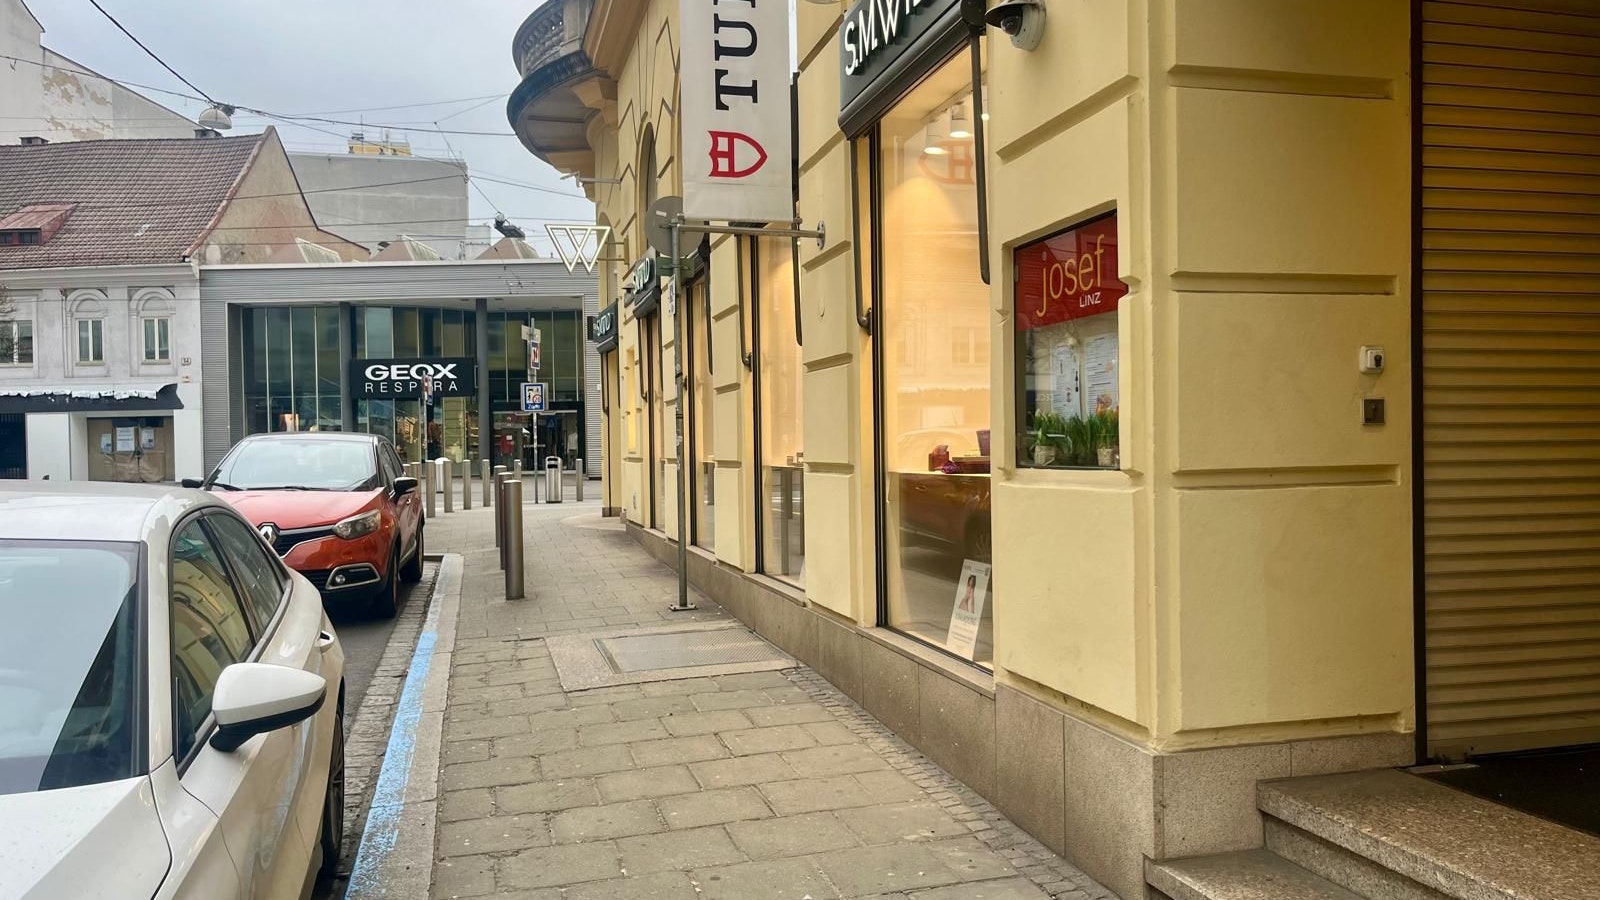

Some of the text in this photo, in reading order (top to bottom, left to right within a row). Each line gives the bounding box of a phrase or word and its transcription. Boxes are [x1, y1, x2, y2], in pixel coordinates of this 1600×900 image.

[713, 0, 758, 111] TU
[844, 0, 921, 76] S.M.W
[1036, 234, 1105, 317] josef
[1079, 292, 1102, 307] LINZ
[365, 364, 458, 381] GEOX
[365, 381, 458, 393] RESPRA
